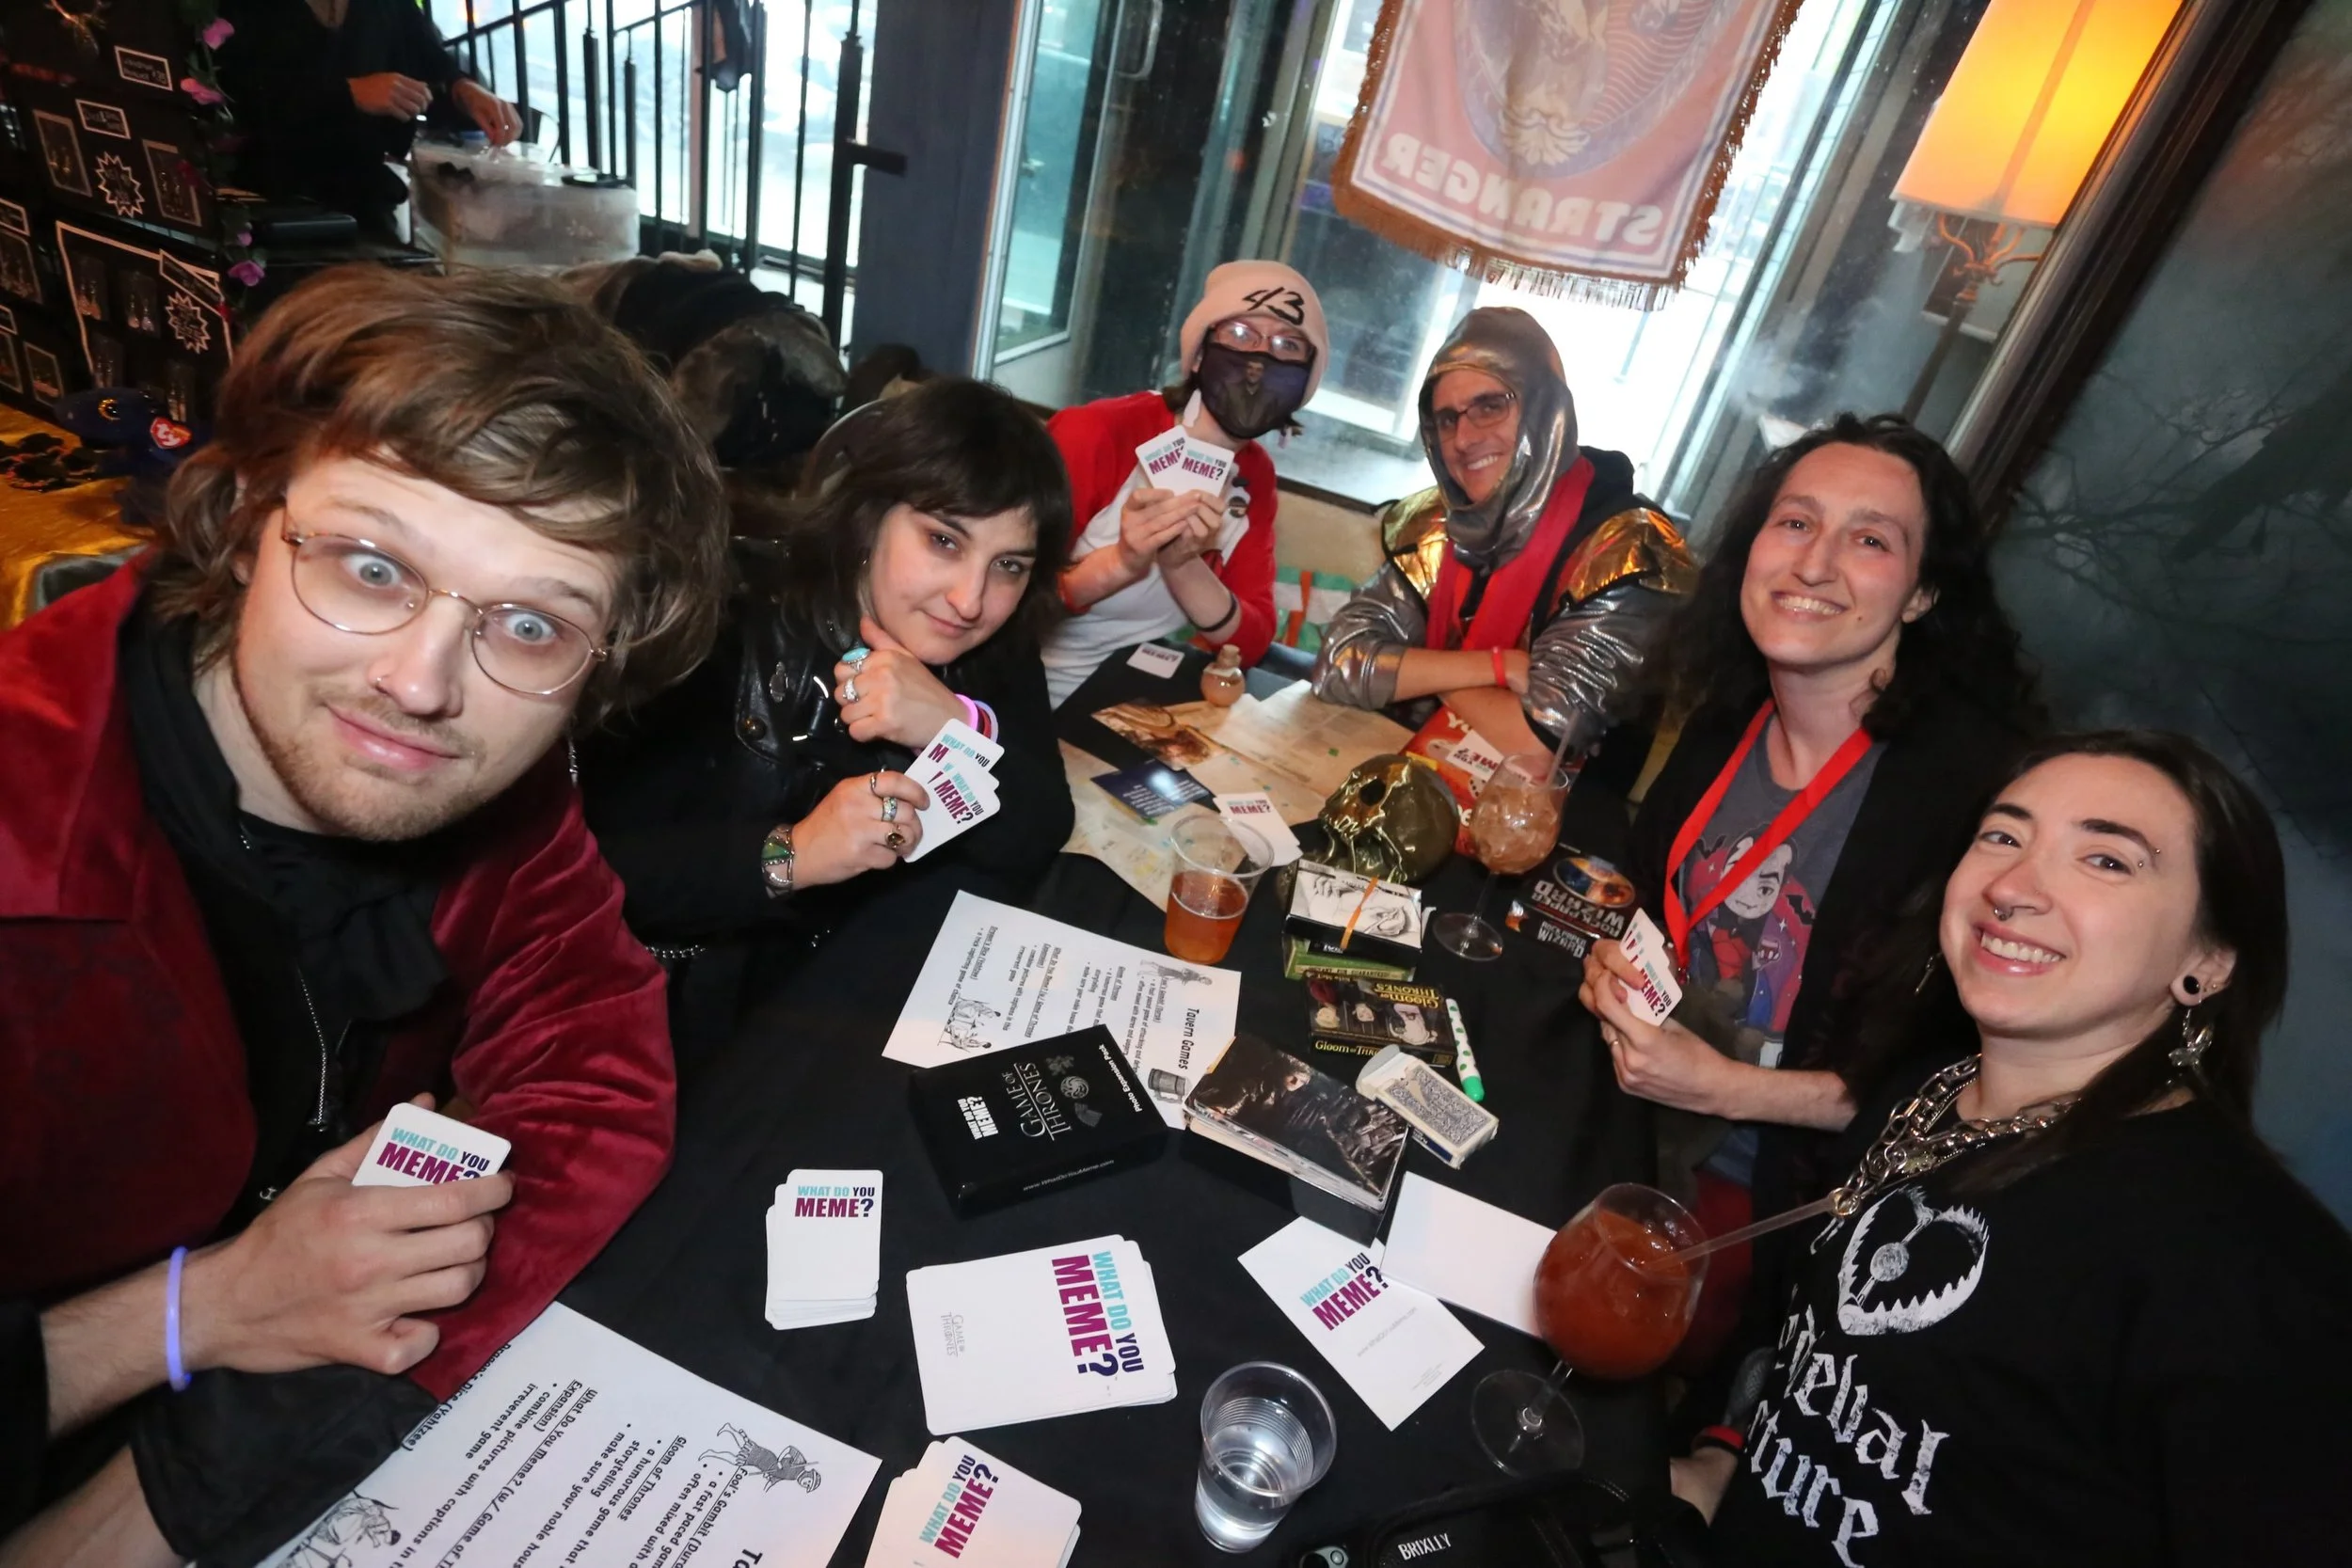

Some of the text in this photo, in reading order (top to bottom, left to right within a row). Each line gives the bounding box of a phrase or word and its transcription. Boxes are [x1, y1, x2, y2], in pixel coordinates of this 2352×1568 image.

[1182, 456, 1224, 480] MEME?
[975, 752, 990, 768] YOU
[935, 780, 974, 825] MEME?
[971, 800, 985, 816] YOU
[1230, 804, 1271, 815] MEME?
[1533, 879, 1625, 927] WIZARD
[1578, 913, 1620, 938] ROCK
[1375, 982, 1440, 1000] THRONES
[1390, 995, 1439, 1010] Gloom
[1659, 990, 1674, 1006] YOU
[1097, 1043, 1111, 1061] Pack
[1178, 1006, 1199, 1069] Tavern Games
[1315, 1040, 1350, 1053] Gloom
[1106, 1058, 1131, 1093] Expansion
[966, 1096, 998, 1136] MEME?
[1006, 1085, 1044, 1136] GAME
[1019, 1061, 1071, 1140] THRONES
[1125, 1091, 1142, 1113] Photo
[390, 1128, 491, 1171] WHAT DO YOU
[795, 1197, 875, 1218] MEME?
[797, 1185, 876, 1197] WHAT DO YOU
[1299, 1252, 1372, 1307] WHAT DO YOU
[1052, 1254, 1120, 1377] MEME?
[1092, 1250, 1145, 1372] WHAT DO YOU
[1311, 1266, 1390, 1331] MEME?
[462, 1380, 537, 1461] irreverent game
[514, 1389, 552, 1432] combine
[532, 1378, 582, 1433] Expansion)
[401, 1400, 453, 1453] (Yahtzee)
[599, 1430, 625, 1460] make
[475, 1428, 516, 1473] pictures
[589, 1436, 642, 1500] storytelling
[449, 1386, 598, 1560] What Do You Meme? (w/ Game of
[453, 1470, 481, 1499] with
[580, 1459, 602, 1484] sure
[617, 1434, 687, 1524] Gloom of Thrones
[707, 1480, 717, 1488] a
[722, 1466, 748, 1499] Fool's
[559, 1481, 583, 1511] your
[564, 1447, 656, 1565] a humorous game that
[691, 1488, 713, 1513] fast
[919, 1454, 977, 1544] WHAT DO YOU
[933, 1463, 999, 1559] MEME?
[409, 1495, 457, 1547] captions
[534, 1509, 564, 1543] noble
[635, 1471, 703, 1562] often mixed with
[667, 1511, 696, 1545] paced
[696, 1497, 728, 1538] Gambit
[400, 1544, 416, 1560] in
[1397, 1532, 1453, 1560] BRIXLLY
